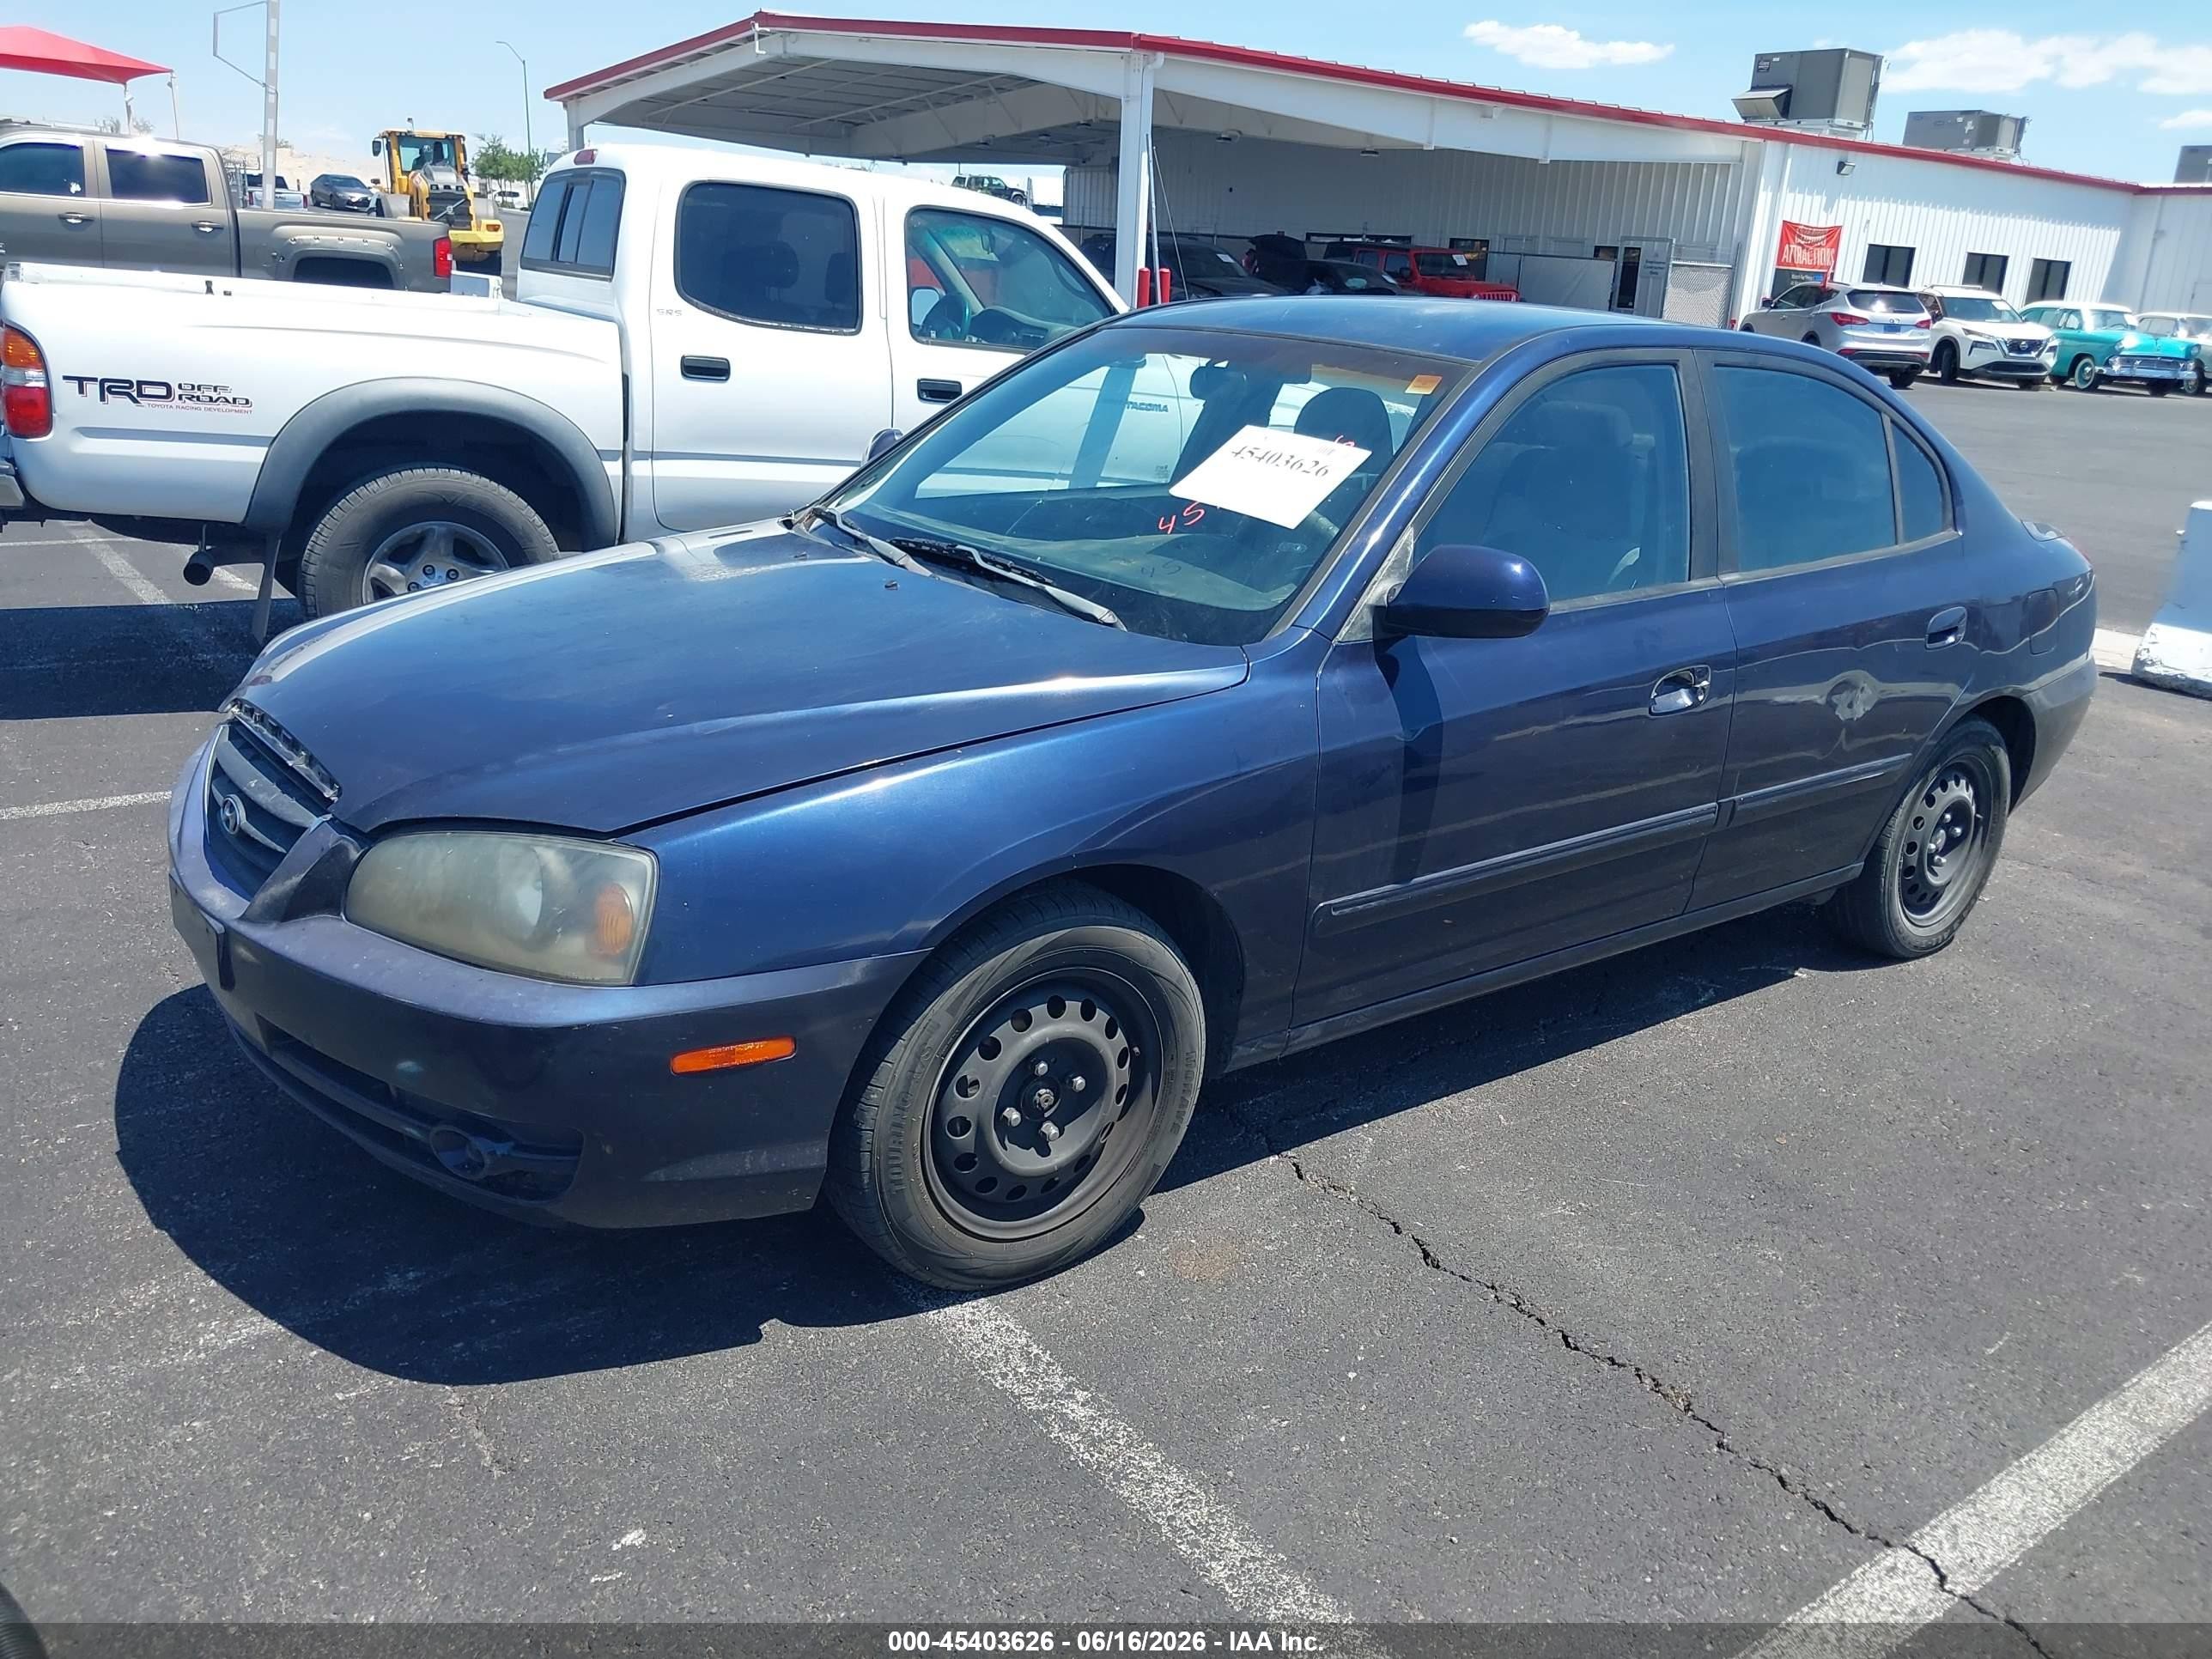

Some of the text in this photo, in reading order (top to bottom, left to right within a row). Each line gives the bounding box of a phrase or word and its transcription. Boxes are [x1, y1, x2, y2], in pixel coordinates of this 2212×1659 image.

[62, 374, 177, 407] TRD
[177, 382, 233, 396] OFF
[178, 393, 252, 407] ROAD
[204, 406, 253, 415] DEVELOPMENT
[1231, 445, 1329, 477] 45403626
